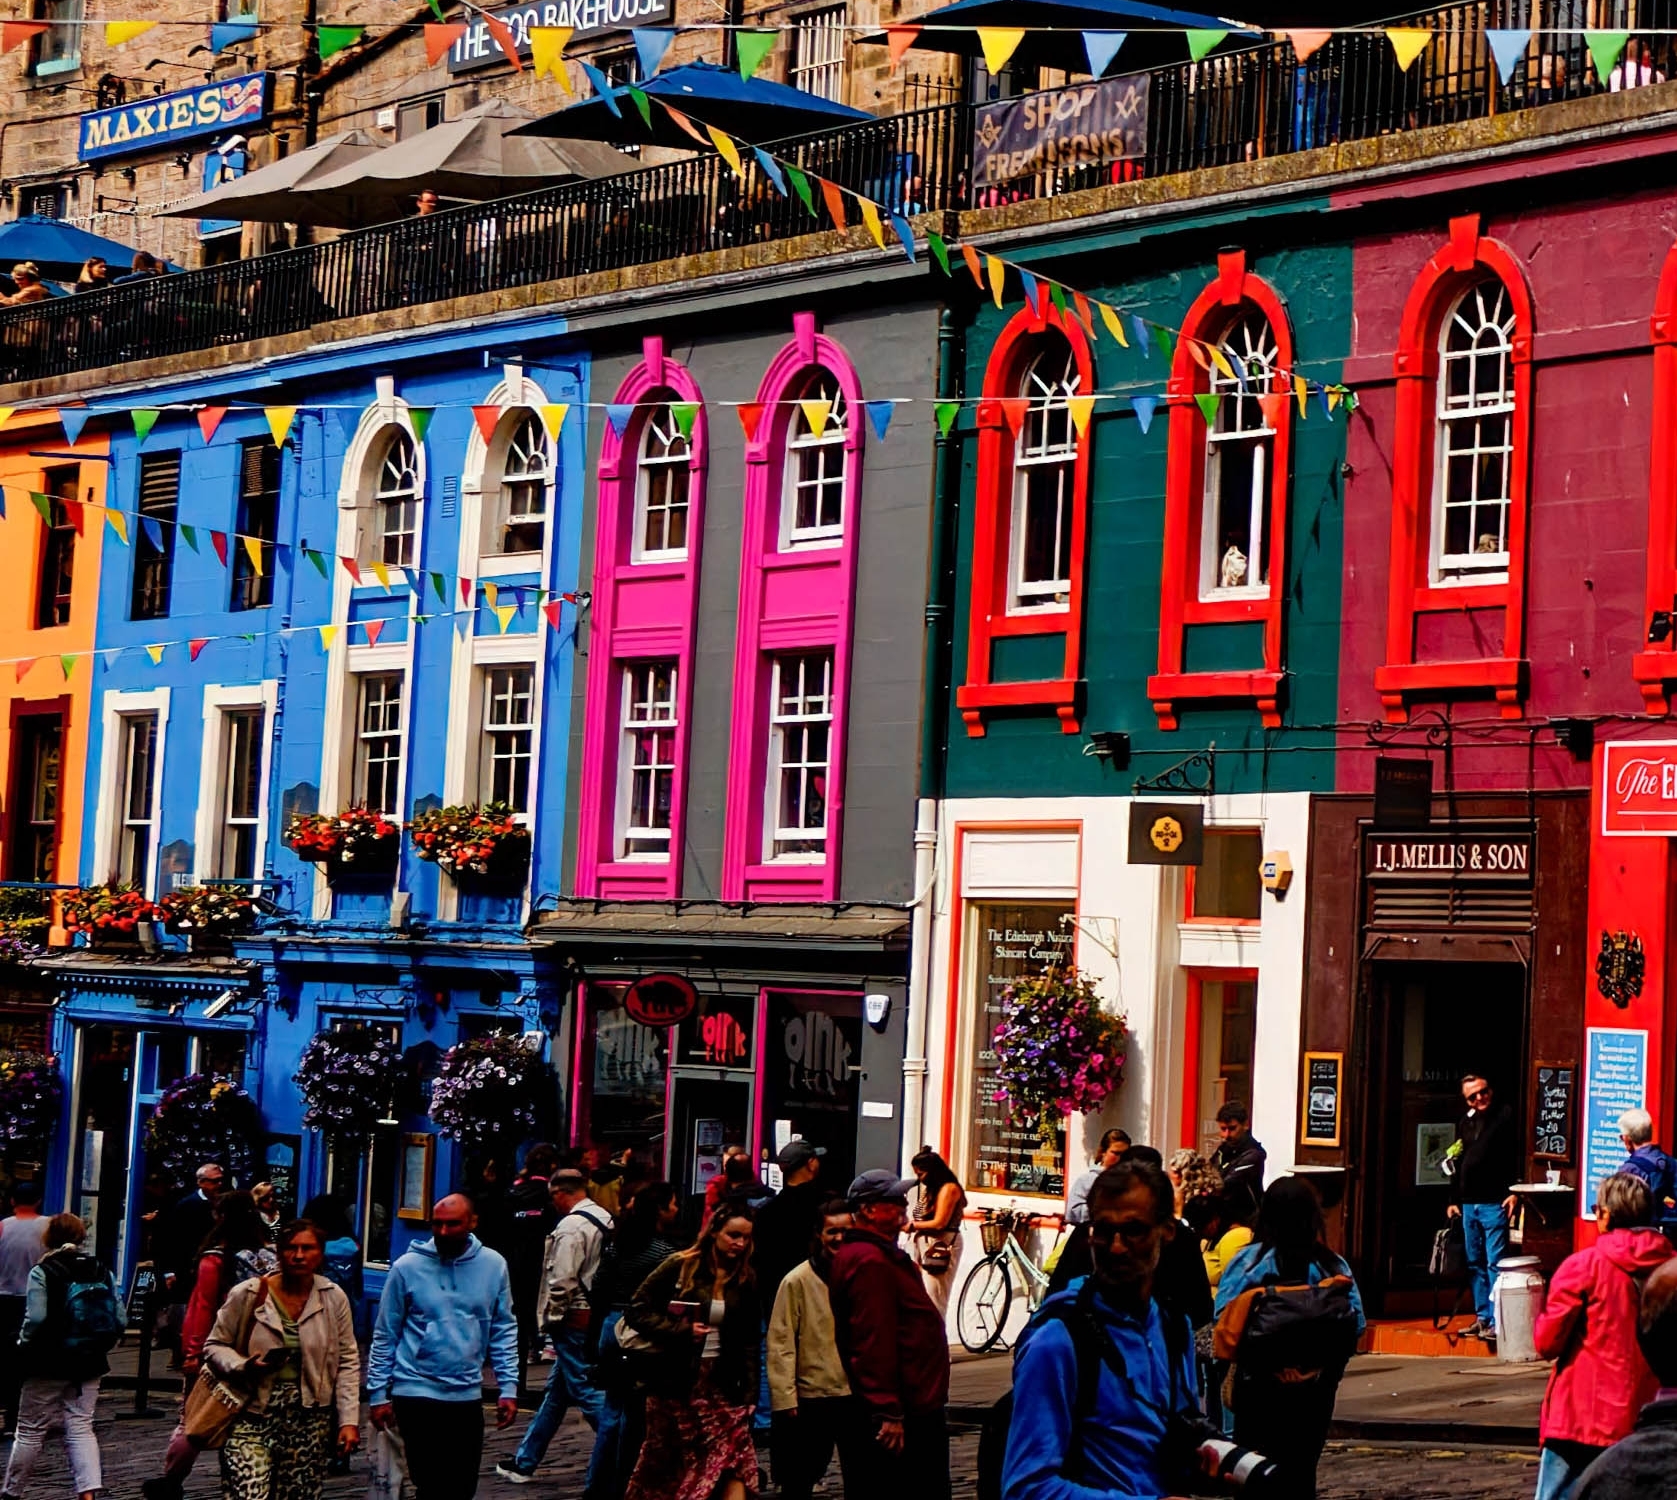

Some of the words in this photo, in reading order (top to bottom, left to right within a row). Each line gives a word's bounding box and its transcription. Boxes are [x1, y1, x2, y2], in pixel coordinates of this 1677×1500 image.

[454, 23, 490, 63] THE
[84, 87, 222, 150] MAXIES
[1023, 87, 1098, 131] SHOP
[1615, 756, 1666, 804] The
[1470, 843, 1483, 870] &
[1486, 843, 1528, 870] SON
